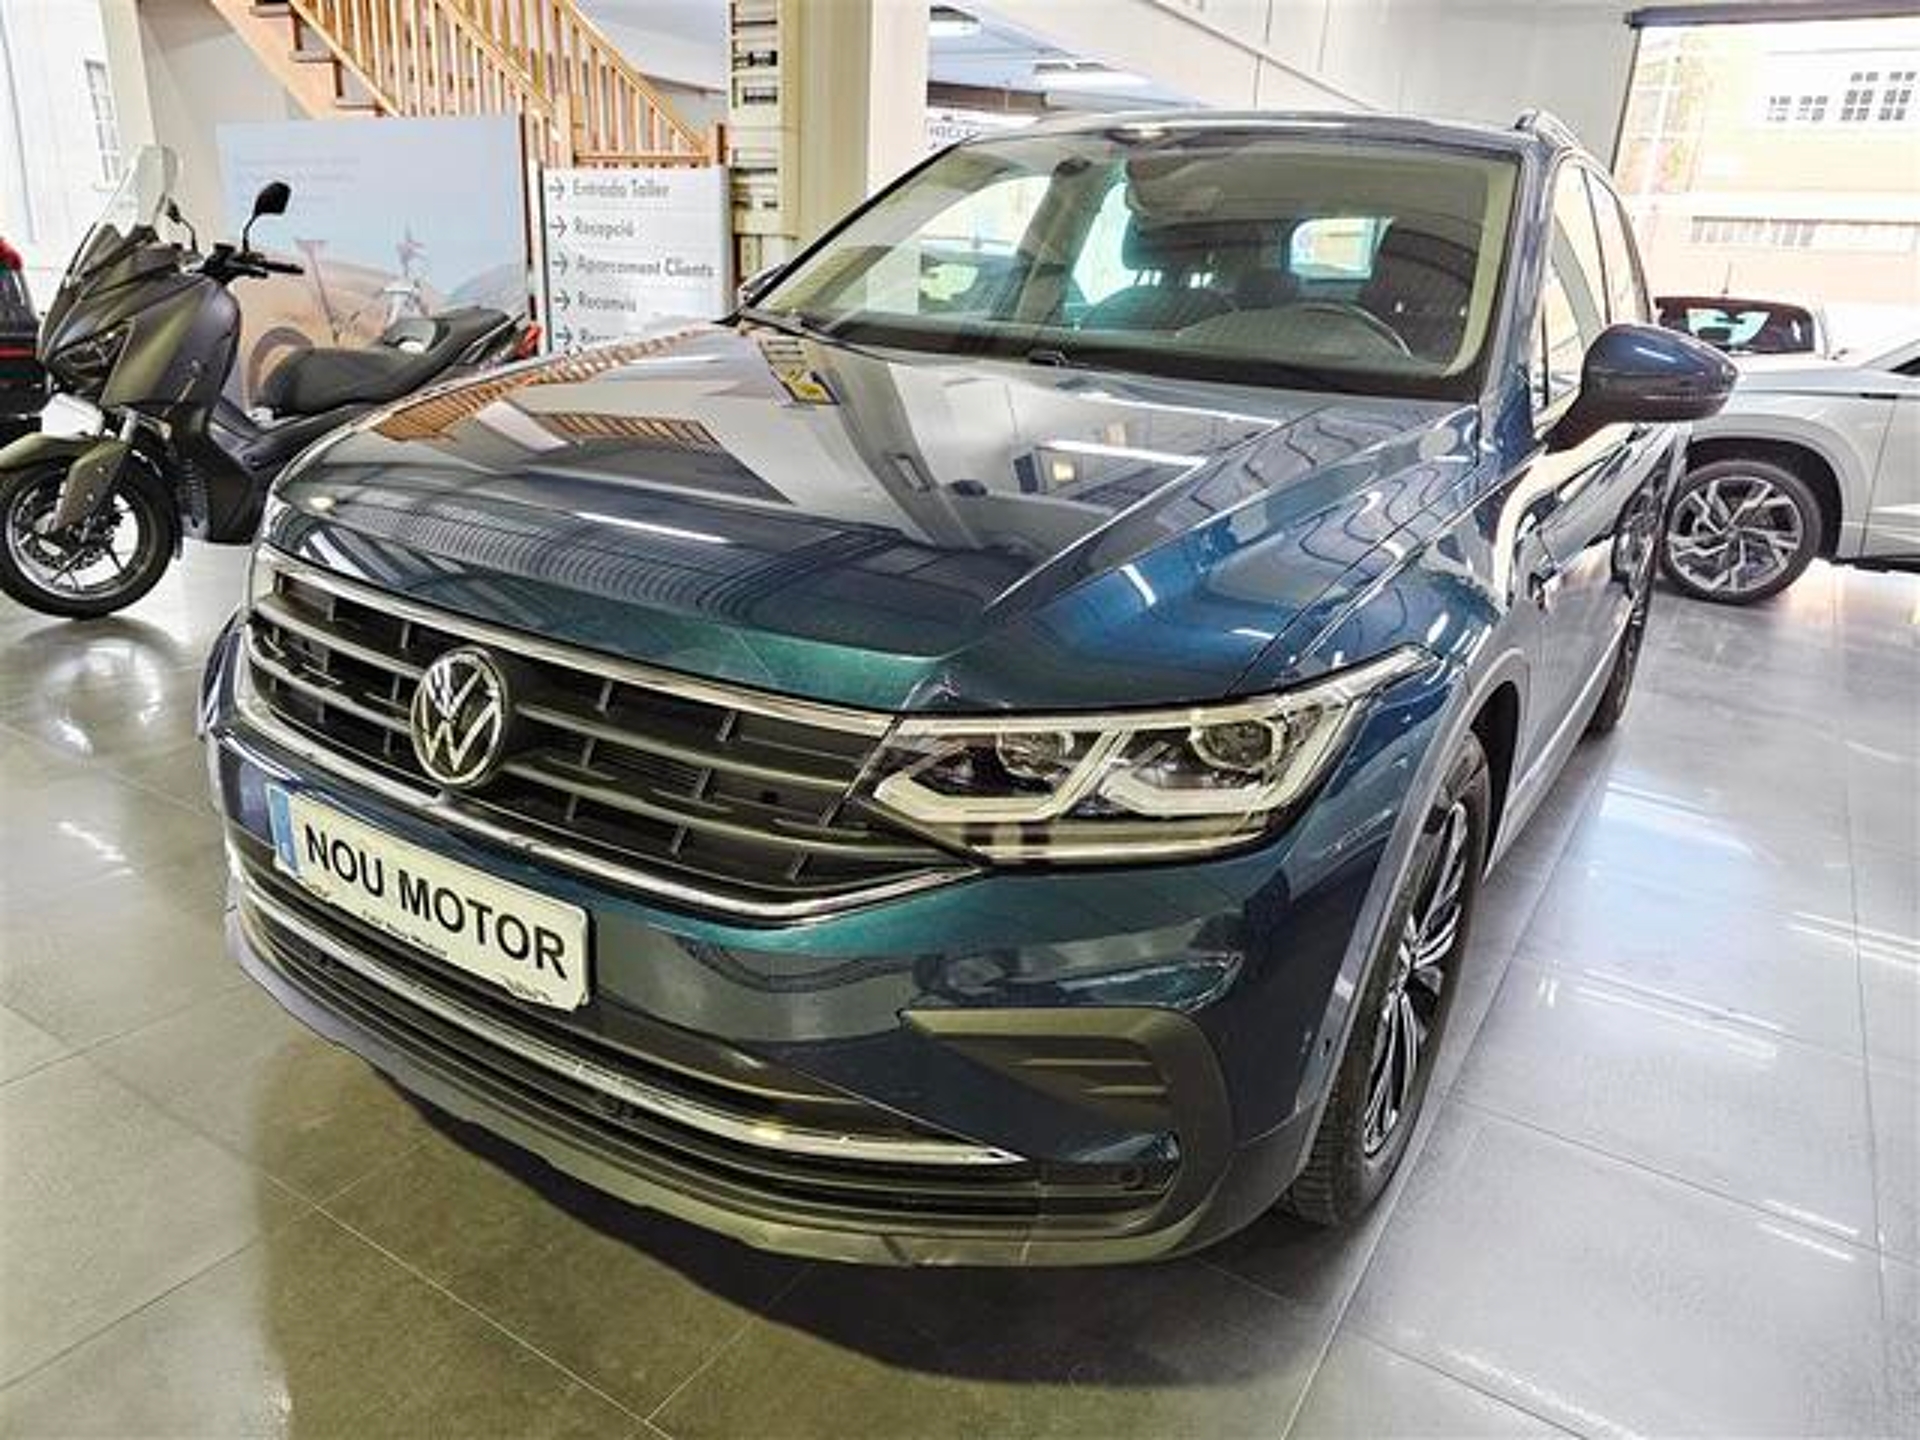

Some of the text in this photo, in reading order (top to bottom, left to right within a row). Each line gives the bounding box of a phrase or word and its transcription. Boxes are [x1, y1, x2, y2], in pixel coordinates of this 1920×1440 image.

[665, 256, 715, 277] Clients
[305, 823, 385, 897] NOU
[398, 868, 568, 980] MOTOR
